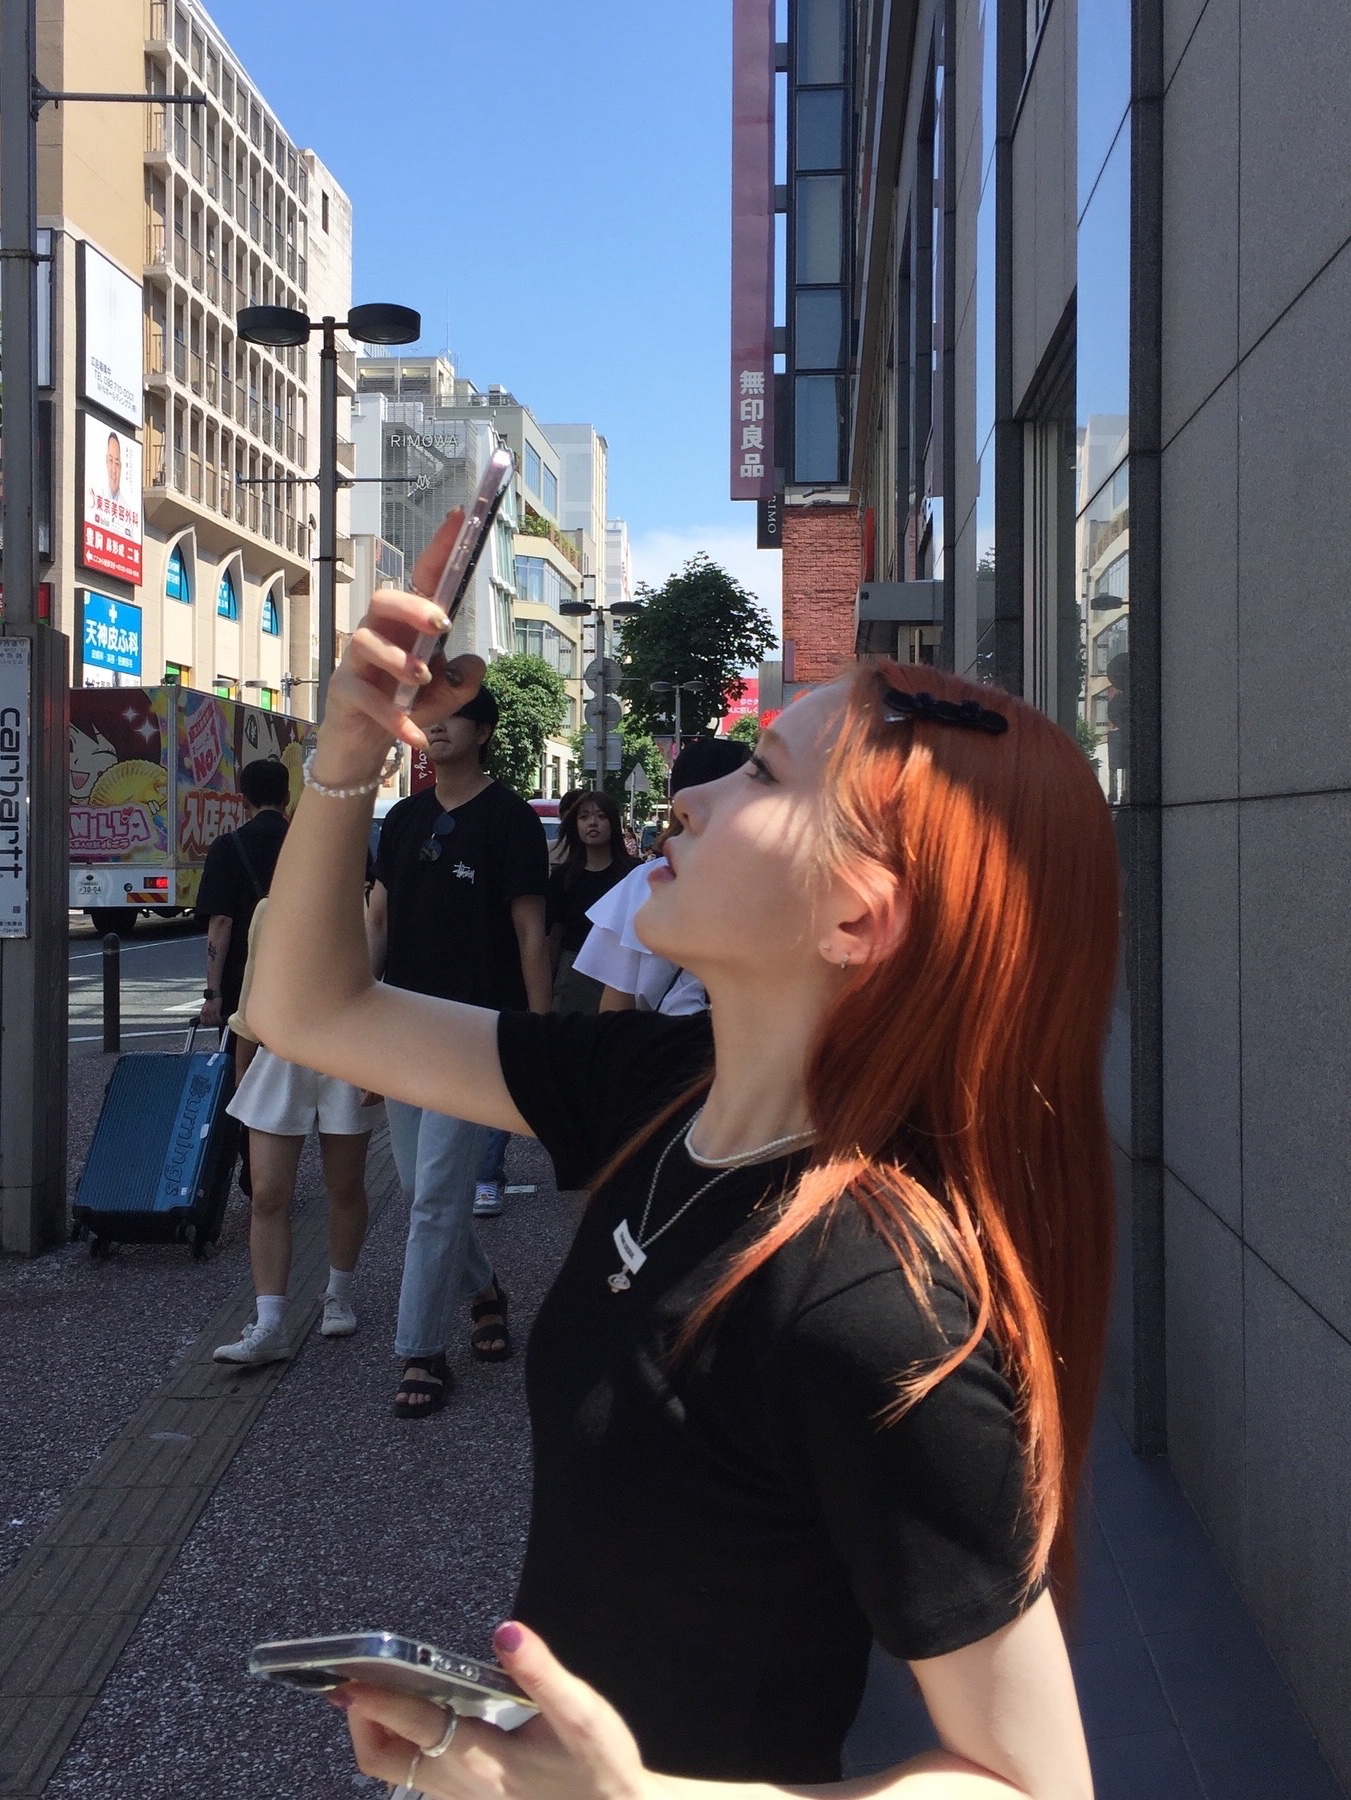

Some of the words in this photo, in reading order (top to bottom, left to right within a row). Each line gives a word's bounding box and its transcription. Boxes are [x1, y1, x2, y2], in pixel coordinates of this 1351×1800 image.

[390, 434, 459, 448] RIMOWA
[739, 370, 765, 478] 無印良品
[96, 494, 138, 527] 東京美容外科
[85, 619, 139, 657] 天神皮ふ科
[414, 749, 433, 780] oy's
[0, 708, 24, 878] carhartt
